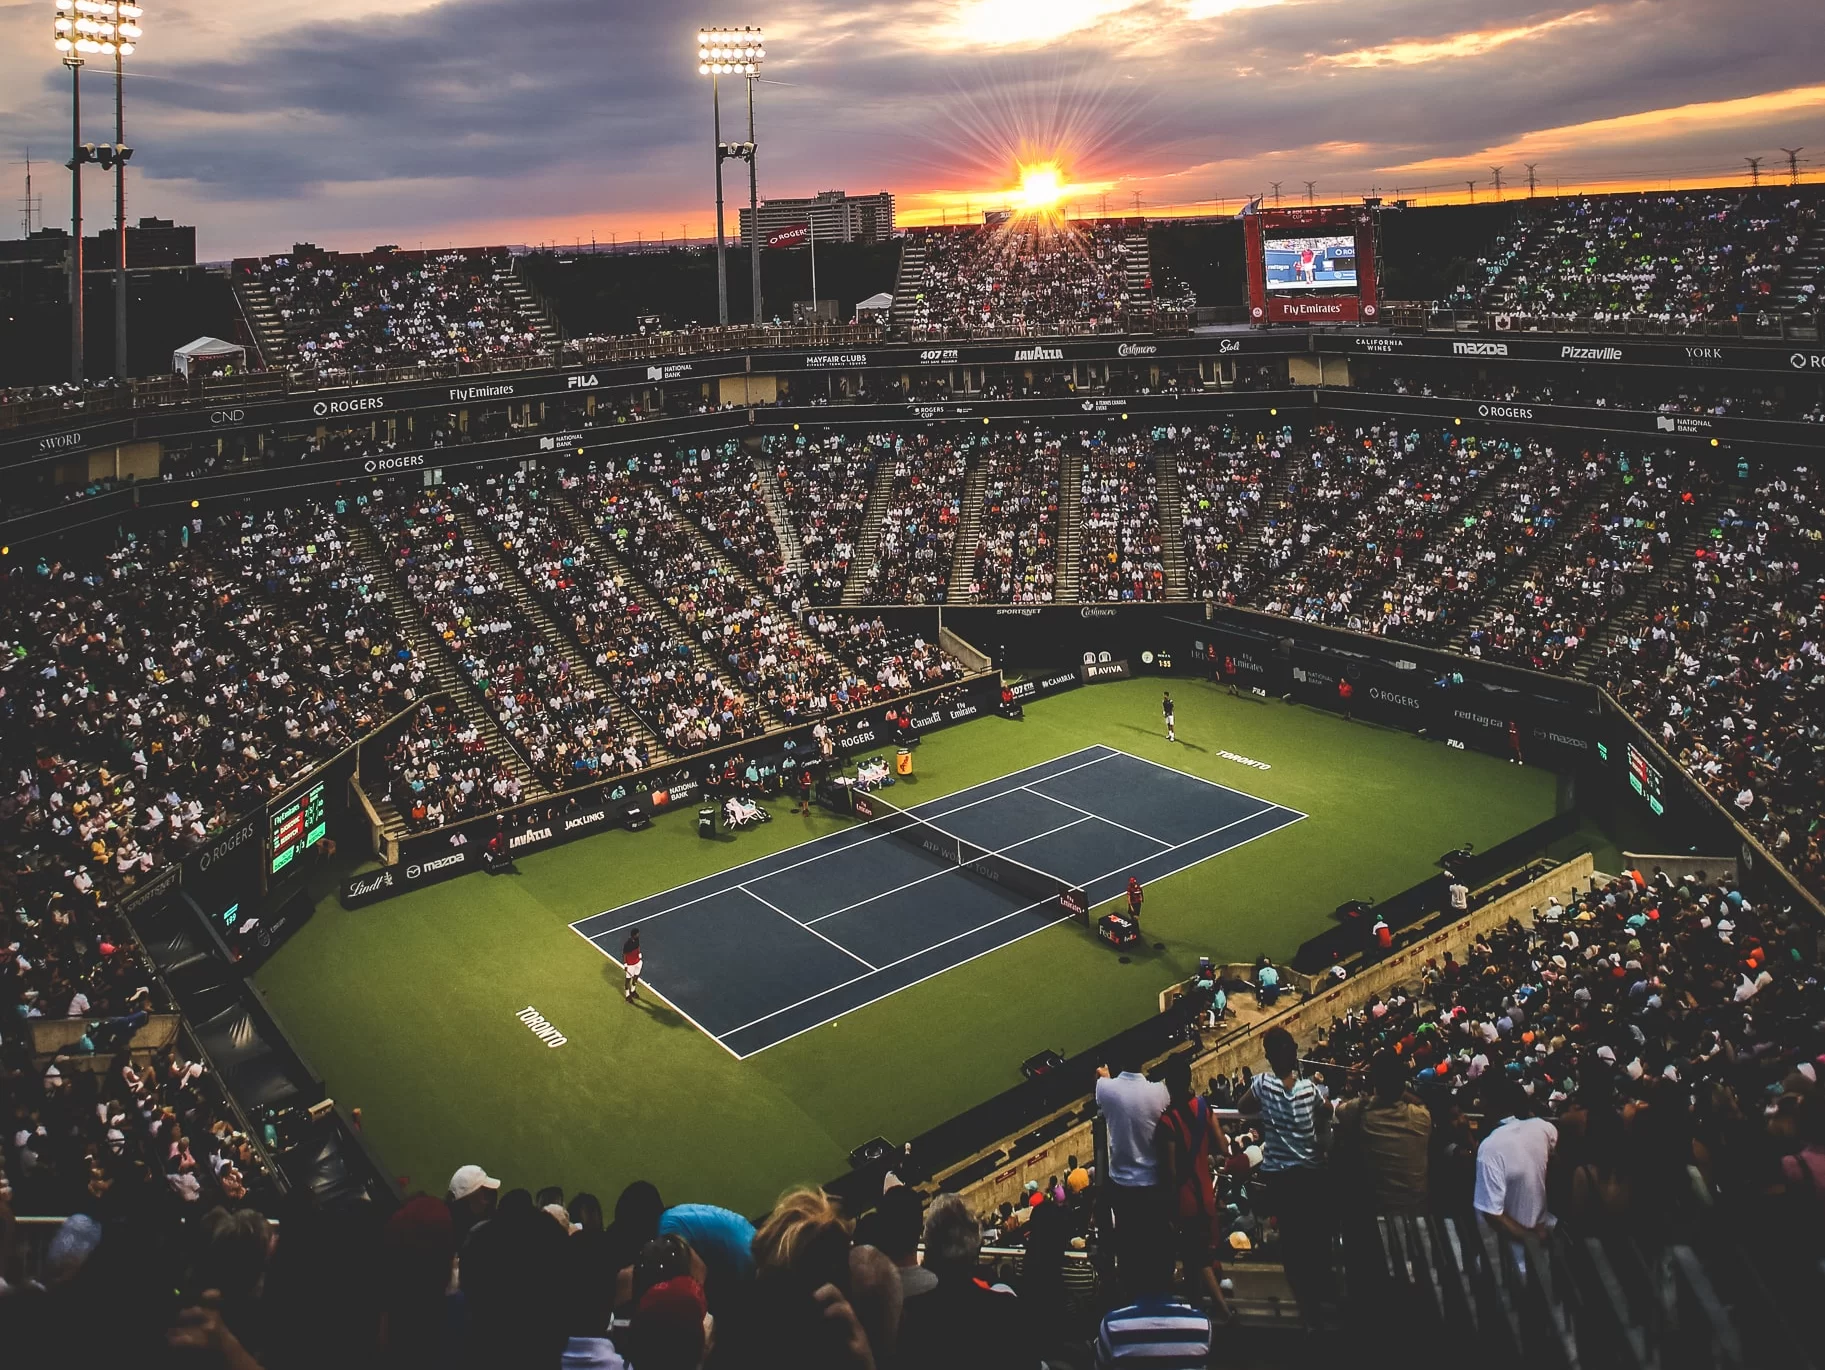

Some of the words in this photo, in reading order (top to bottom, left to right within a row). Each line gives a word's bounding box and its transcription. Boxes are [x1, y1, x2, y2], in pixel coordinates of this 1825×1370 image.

[1283, 304, 1299, 316] Fly
[1300, 303, 1341, 313] Emirates
[1355, 338, 1403, 346] CALIFORNIA
[1452, 342, 1508, 356] mazda
[806, 355, 839, 364] MAYFAIR
[840, 354, 867, 362] CLUBS
[920, 350, 942, 360] 407
[1014, 346, 1064, 361] LAVAZZA
[1561, 346, 1622, 360] Pizzaville
[1685, 347, 1723, 359] YORK
[664, 364, 693, 373] NATIONAL
[568, 374, 599, 388] FILA
[450, 389, 468, 401] Fly
[469, 385, 514, 399] Emirates
[330, 397, 384, 413] ROGERS
[211, 409, 245, 423] CND
[1490, 406, 1533, 419] ROGERS
[1677, 418, 1712, 427] NATIONAL
[1677, 425, 1698, 433] BANK
[39, 432, 81, 452] SWORD
[556, 434, 583, 442] NATIONAL
[378, 455, 424, 470] ROGERS
[996, 608, 1042, 616] SPORTSNET
[1098, 665, 1123, 675] AVIVA
[1048, 672, 1076, 687] CAMBRIA
[1252, 686, 1266, 697] FILA
[1381, 690, 1420, 709] ROGERS
[950, 705, 977, 719] Emirates
[910, 711, 942, 729] Canada
[841, 730, 876, 748] ROGERS
[1446, 738, 1465, 750] FILA
[1215, 750, 1272, 770] TORONTO
[669, 780, 699, 794] NATIONAL
[671, 790, 689, 801] BANK
[564, 819, 584, 831] JACK
[213, 823, 253, 862] ROGERS
[509, 827, 553, 849] LAVAZZA
[423, 852, 465, 873] mazda
[922, 839, 940, 852] ATP
[975, 863, 1000, 882] TOUR
[347, 875, 383, 898] Lindt
[1099, 924, 1120, 945] FedEx
[515, 1005, 568, 1048] TORONTO
